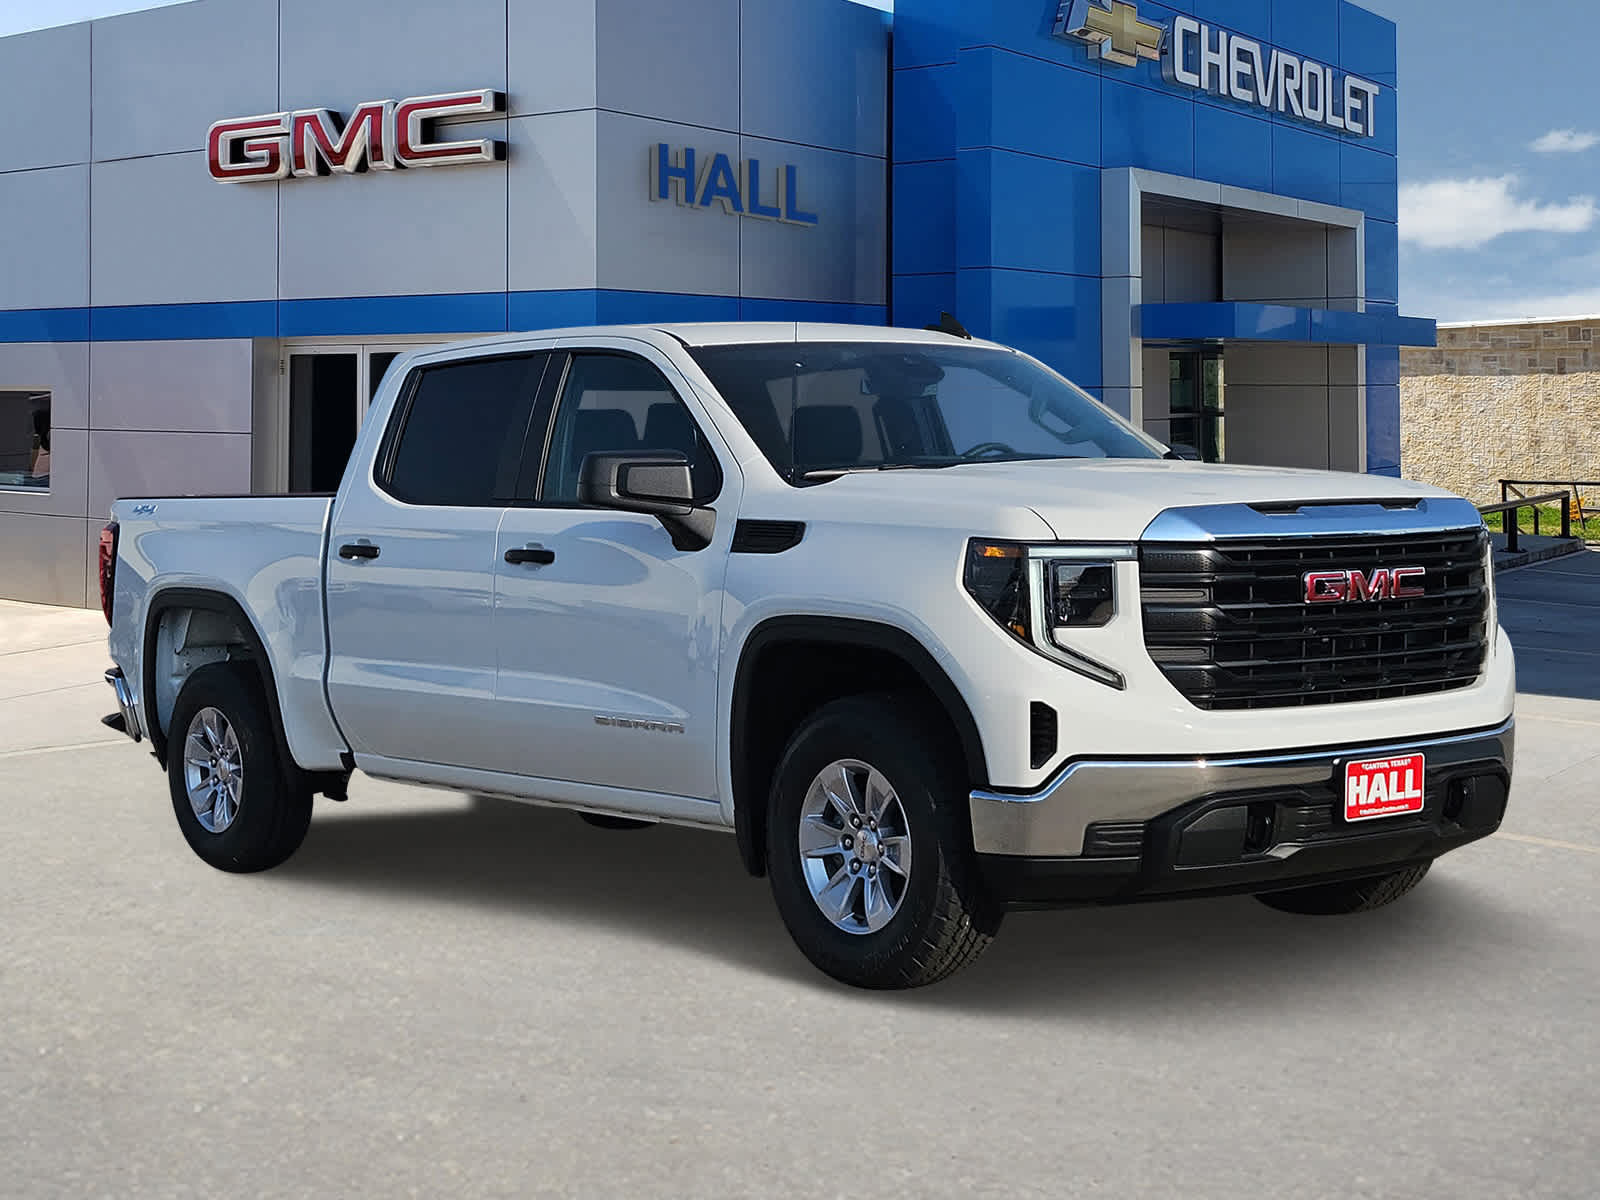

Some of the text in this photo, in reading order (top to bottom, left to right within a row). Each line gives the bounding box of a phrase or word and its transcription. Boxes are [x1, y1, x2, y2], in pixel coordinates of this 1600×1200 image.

[1174, 16, 1380, 137] CHEVROLET
[208, 88, 502, 183] GMC
[652, 143, 818, 225] HALL
[1303, 566, 1425, 603] GMC
[594, 714, 685, 734] SIERRA
[1348, 768, 1422, 807] HALL
